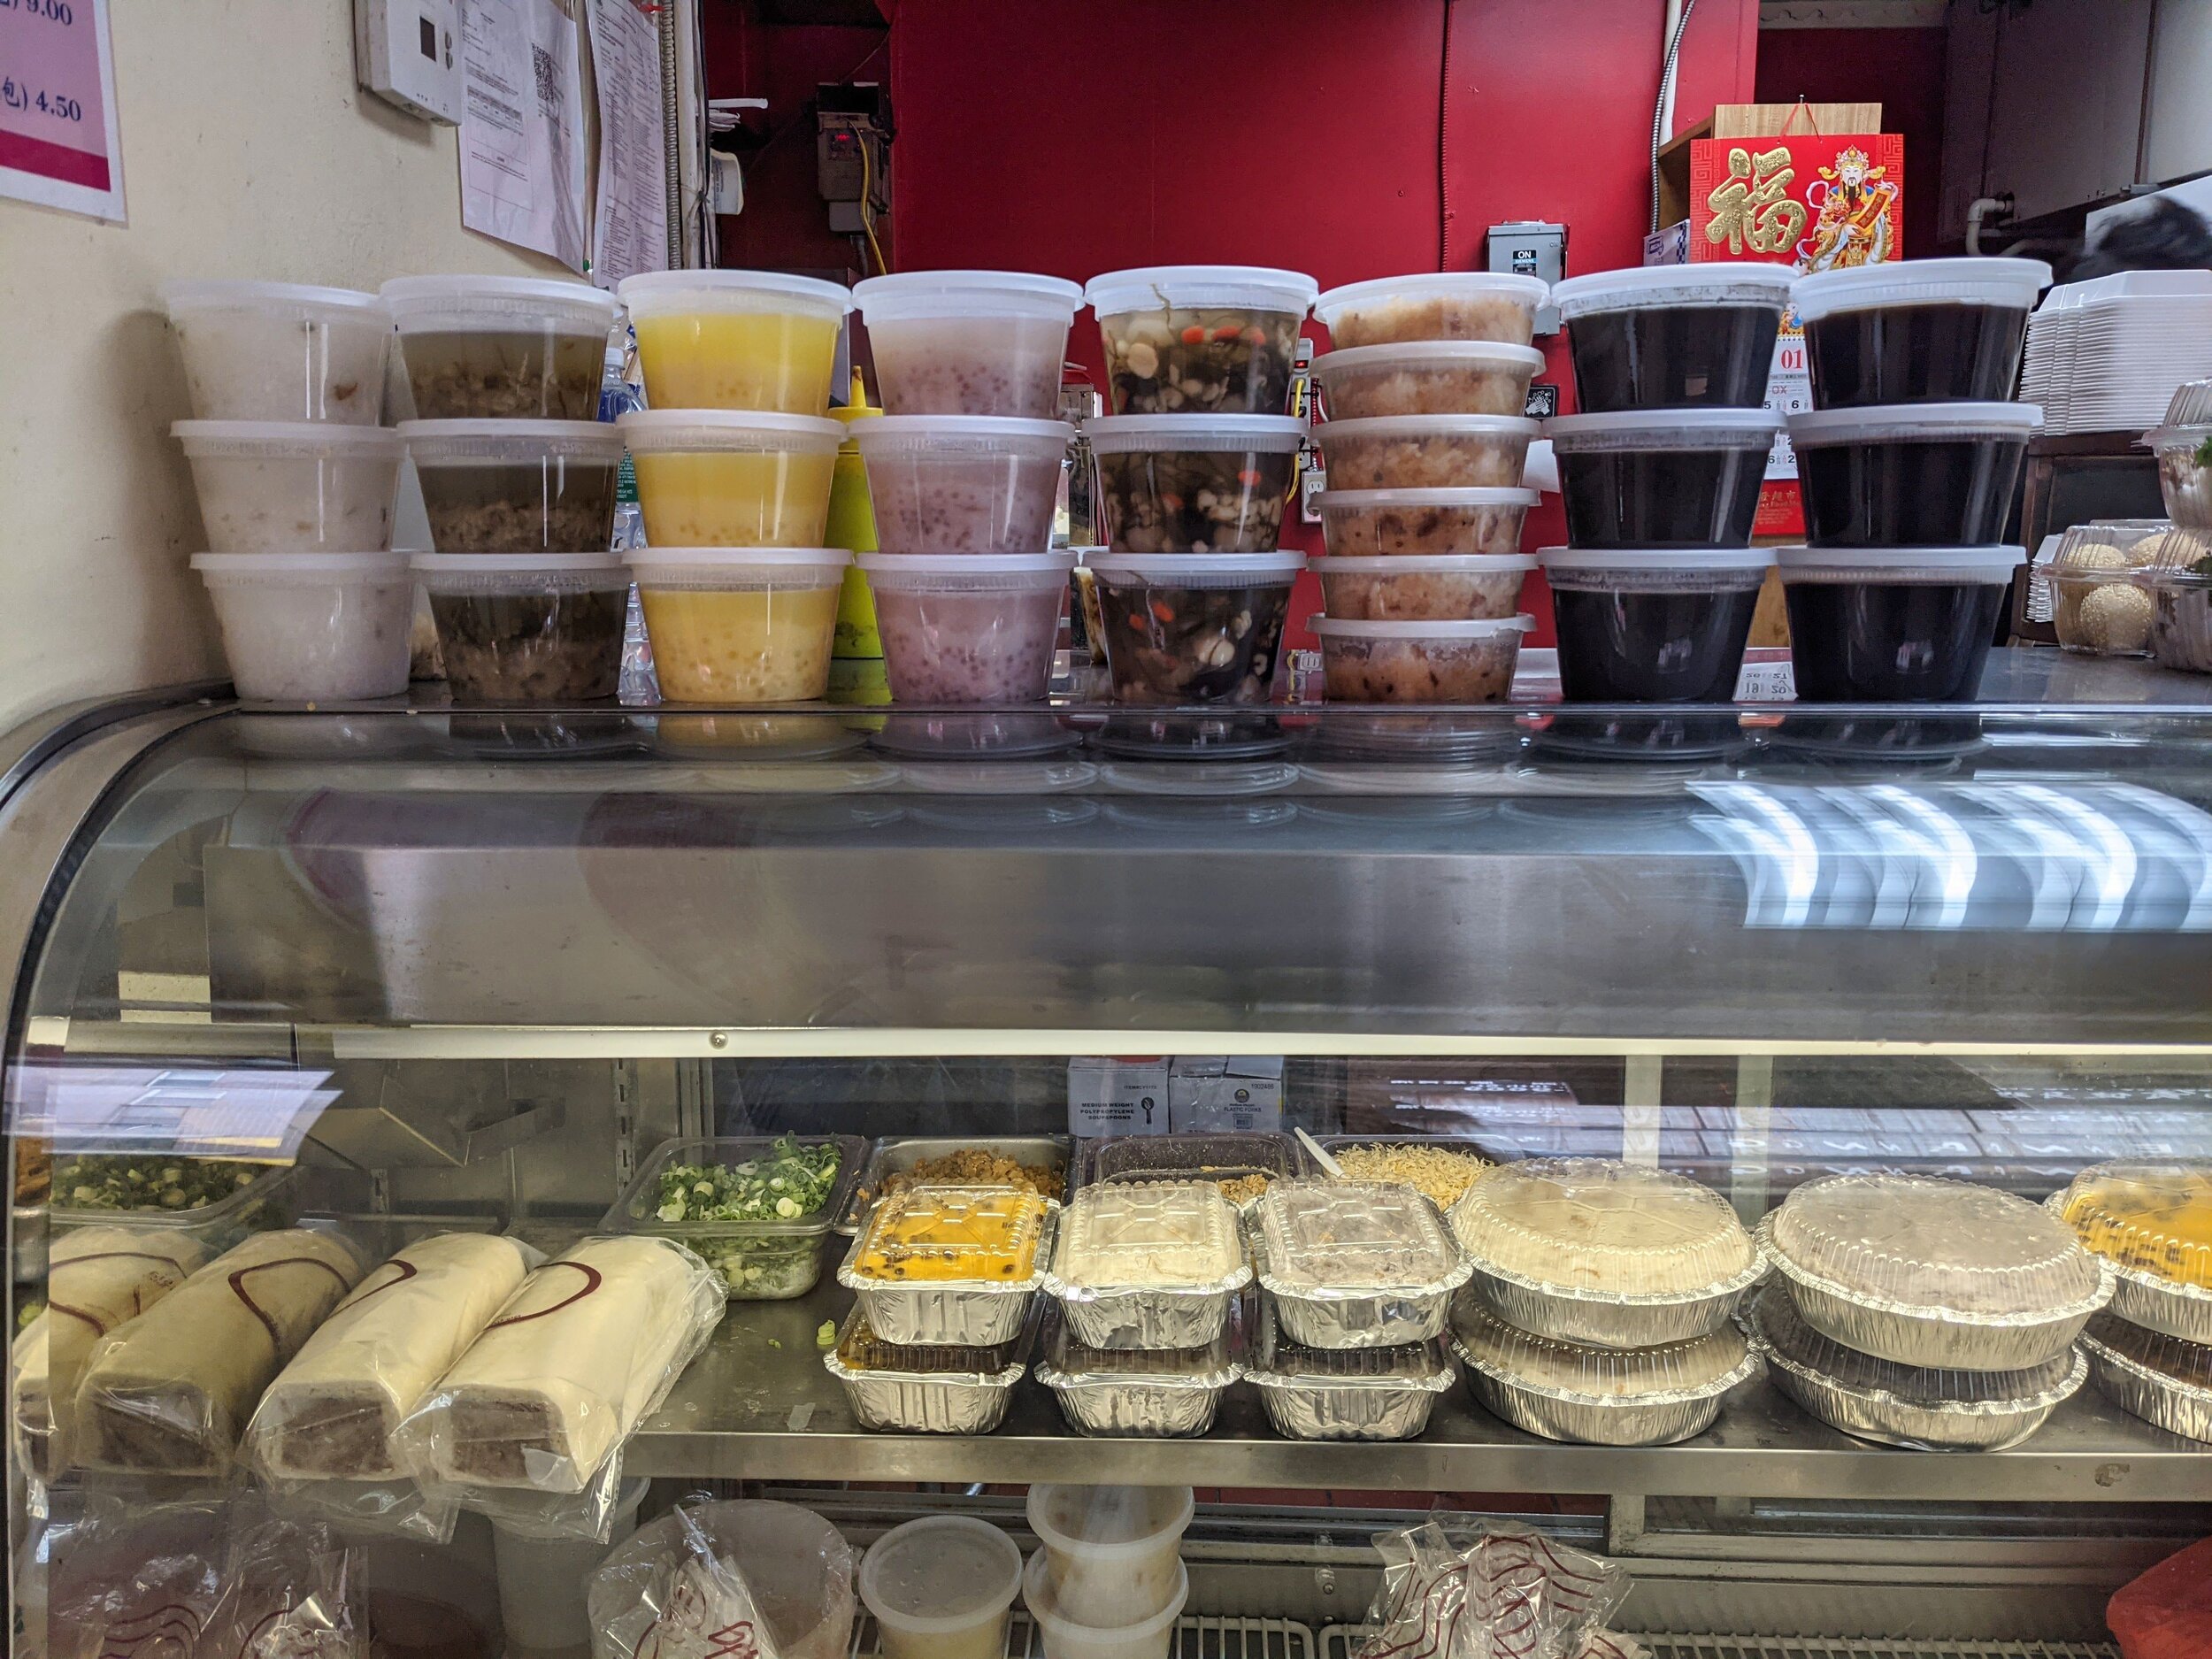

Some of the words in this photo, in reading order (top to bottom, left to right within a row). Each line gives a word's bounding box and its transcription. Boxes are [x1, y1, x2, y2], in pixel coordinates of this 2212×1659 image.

[35, 90, 81, 121] 4.50
[1705, 147, 1808, 255] 福
[1781, 349, 1802, 369] 01
[1771, 385, 1788, 395] OX
[1763, 401, 1771, 410] 5
[1791, 400, 1800, 409] 6
